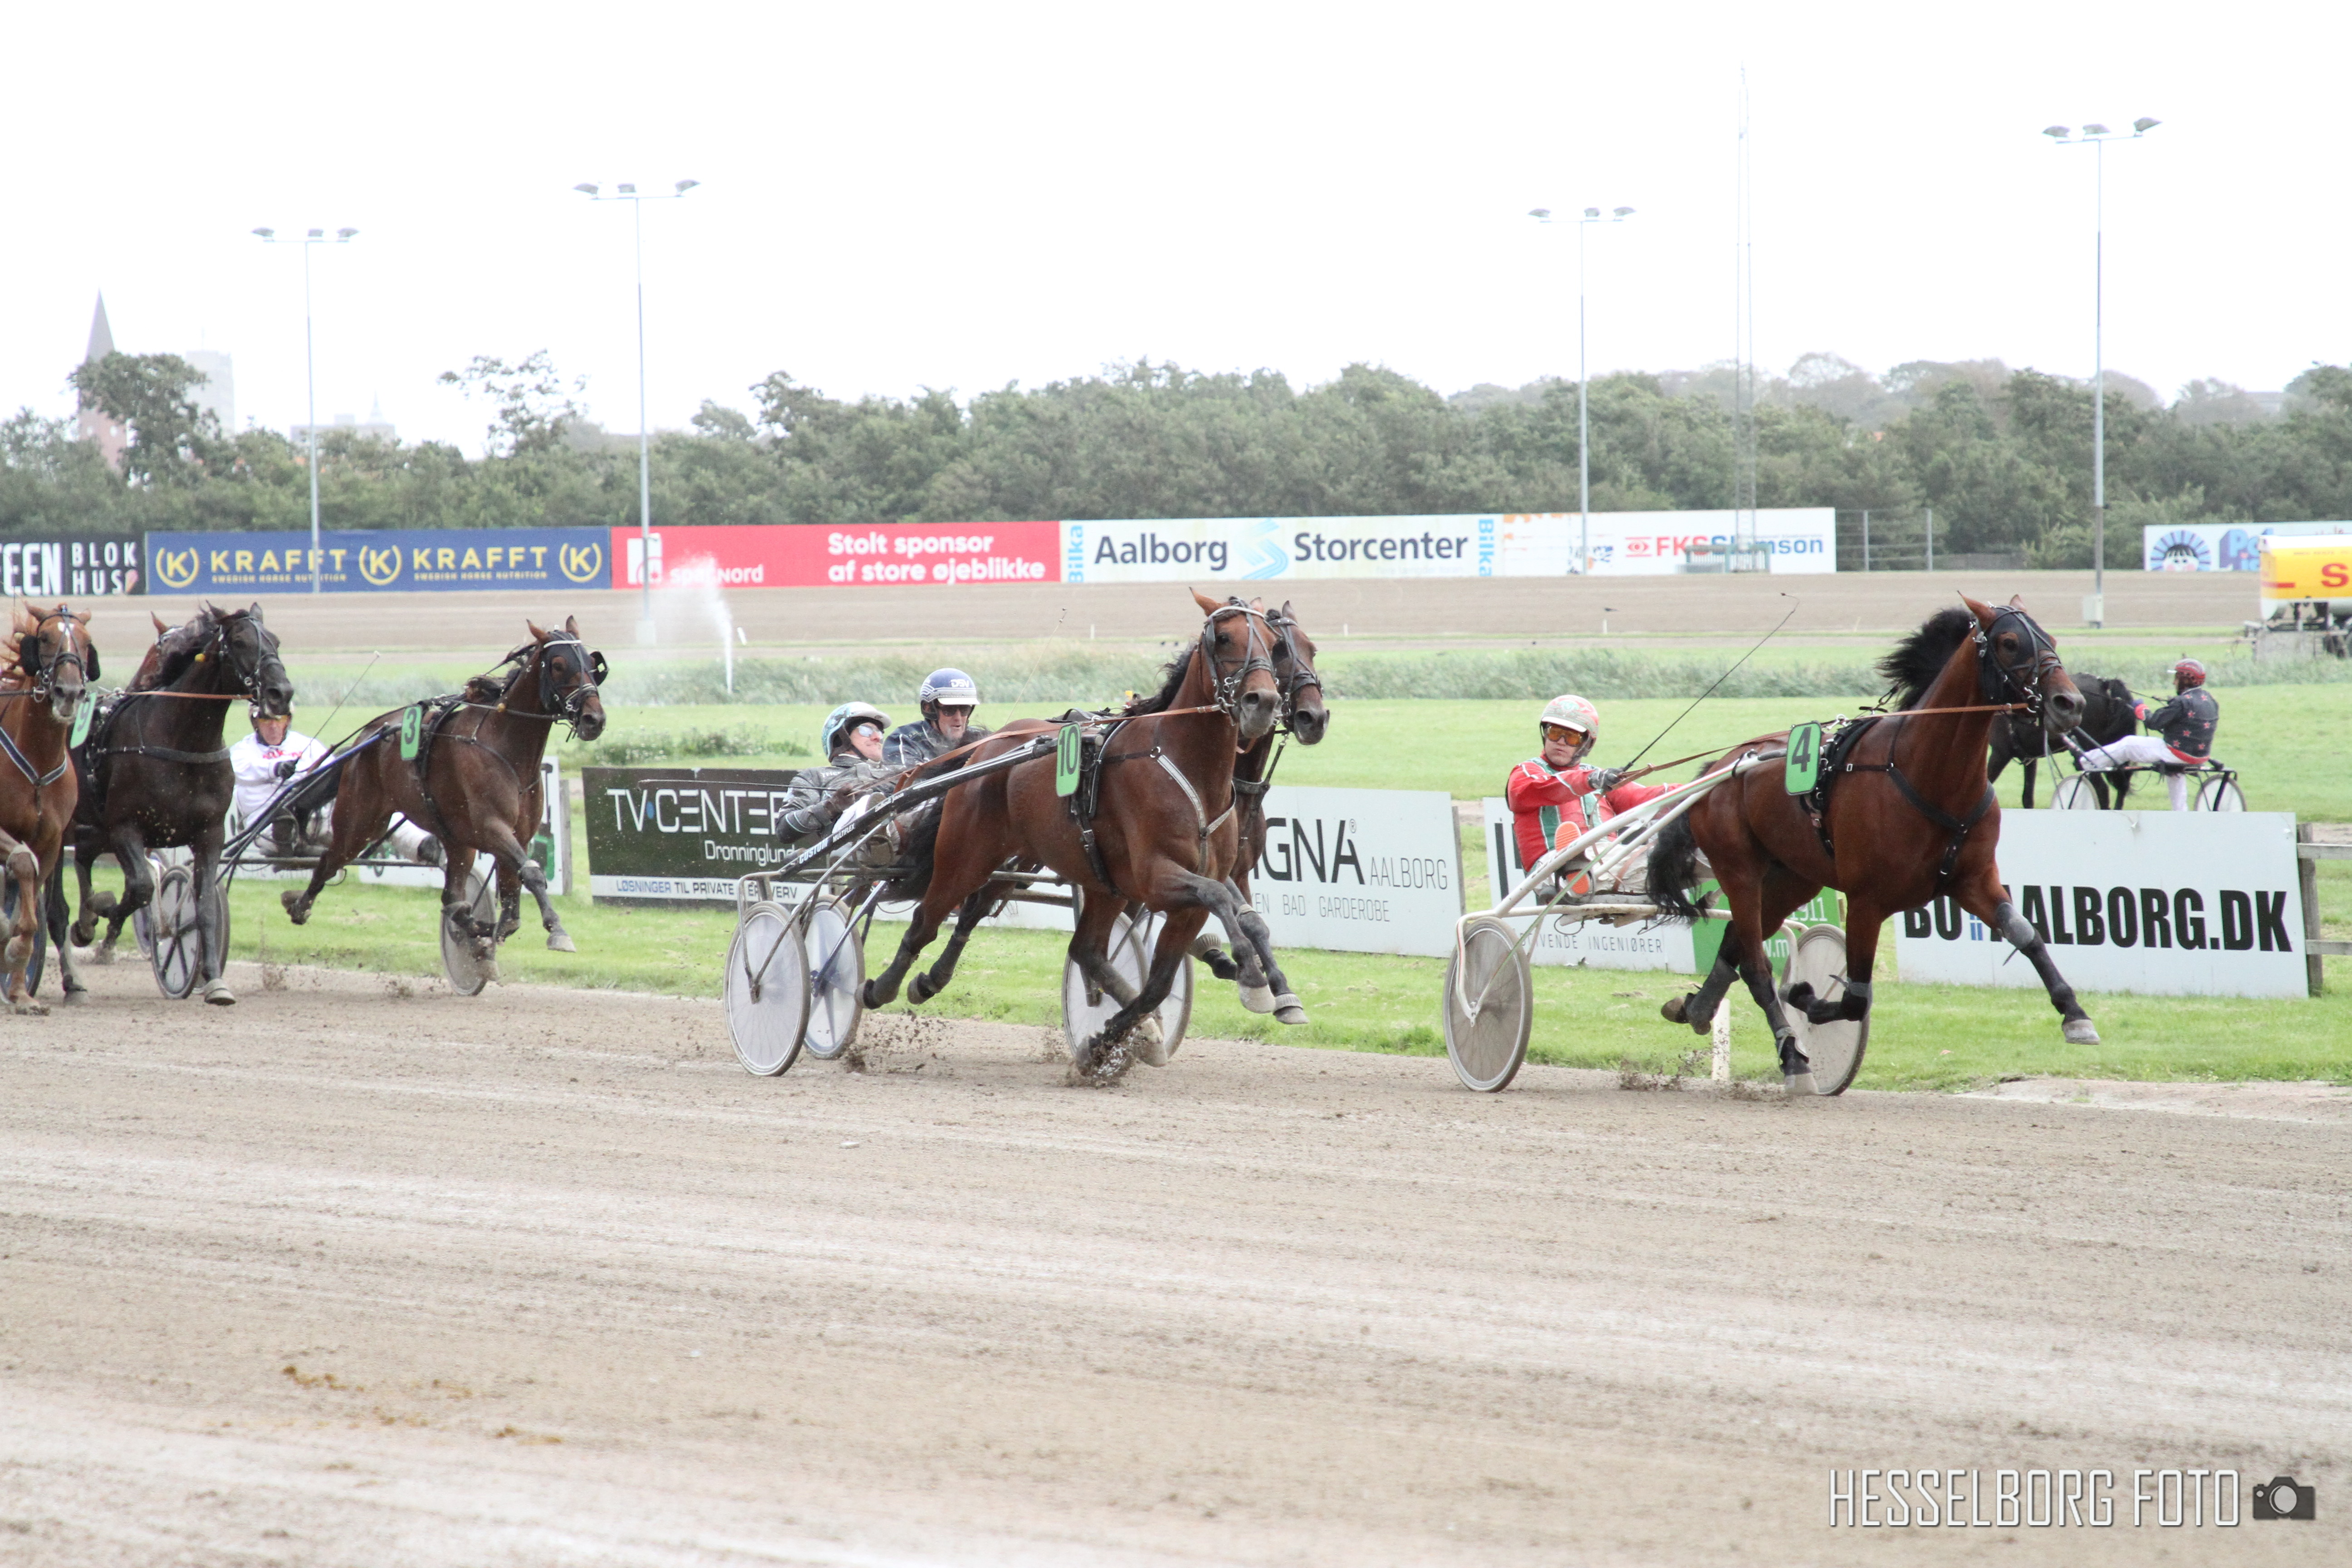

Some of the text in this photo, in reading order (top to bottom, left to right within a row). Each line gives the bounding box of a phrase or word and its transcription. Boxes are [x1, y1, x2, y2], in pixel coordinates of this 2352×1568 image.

[72, 542, 137, 567] BLOK
[413, 546, 547, 570] KRAFFT
[828, 531, 994, 559] Stolt sponsor
[1068, 525, 1083, 583] Bilka
[1094, 532, 1469, 572] Aalborg Storcenter
[1478, 519, 1494, 576] Bilka
[0, 542, 63, 597] EEN
[211, 549, 347, 573] KRAFFT
[828, 557, 1045, 585] af store øjeblikke
[72, 569, 125, 595] HUS
[404, 708, 417, 745] 3
[1059, 726, 1078, 777] 10
[1791, 726, 1812, 773] 4
[799, 823, 855, 864] CUSTOM MULTIFLEX
[616, 879, 671, 893] LØSNINGER
[674, 882, 690, 894] TIL
[692, 882, 735, 895] PRIVATE
[1370, 857, 1448, 890] AALBORG
[1283, 894, 1306, 916] BAD
[1318, 896, 1391, 922] GARDEROBE
[1588, 936, 1663, 953] INGENIØRER
